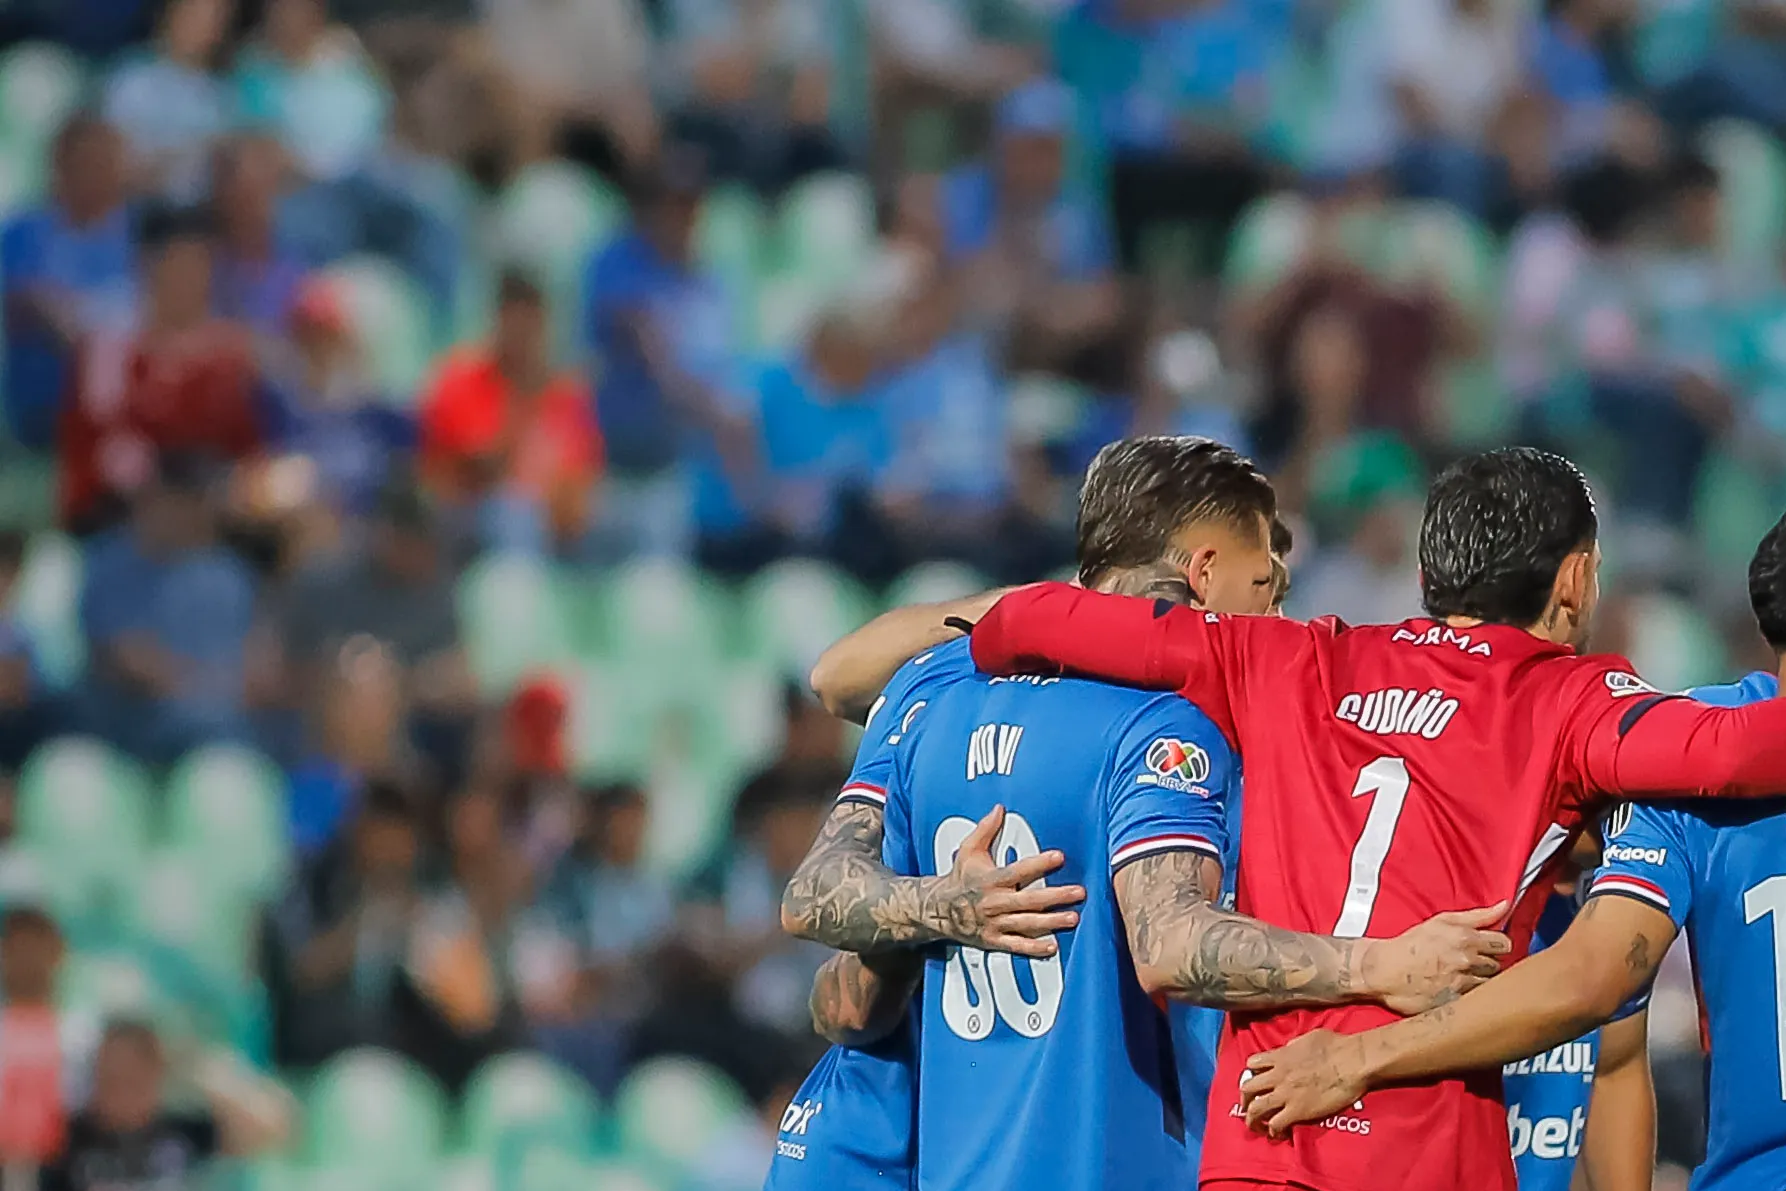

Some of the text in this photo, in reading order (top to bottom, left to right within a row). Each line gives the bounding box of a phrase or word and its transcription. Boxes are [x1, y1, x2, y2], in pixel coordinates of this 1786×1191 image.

[1335, 686, 1460, 739] GUDIÑO
[1332, 756, 1411, 938] 1
[1320, 1115, 1371, 1135] UCOS
